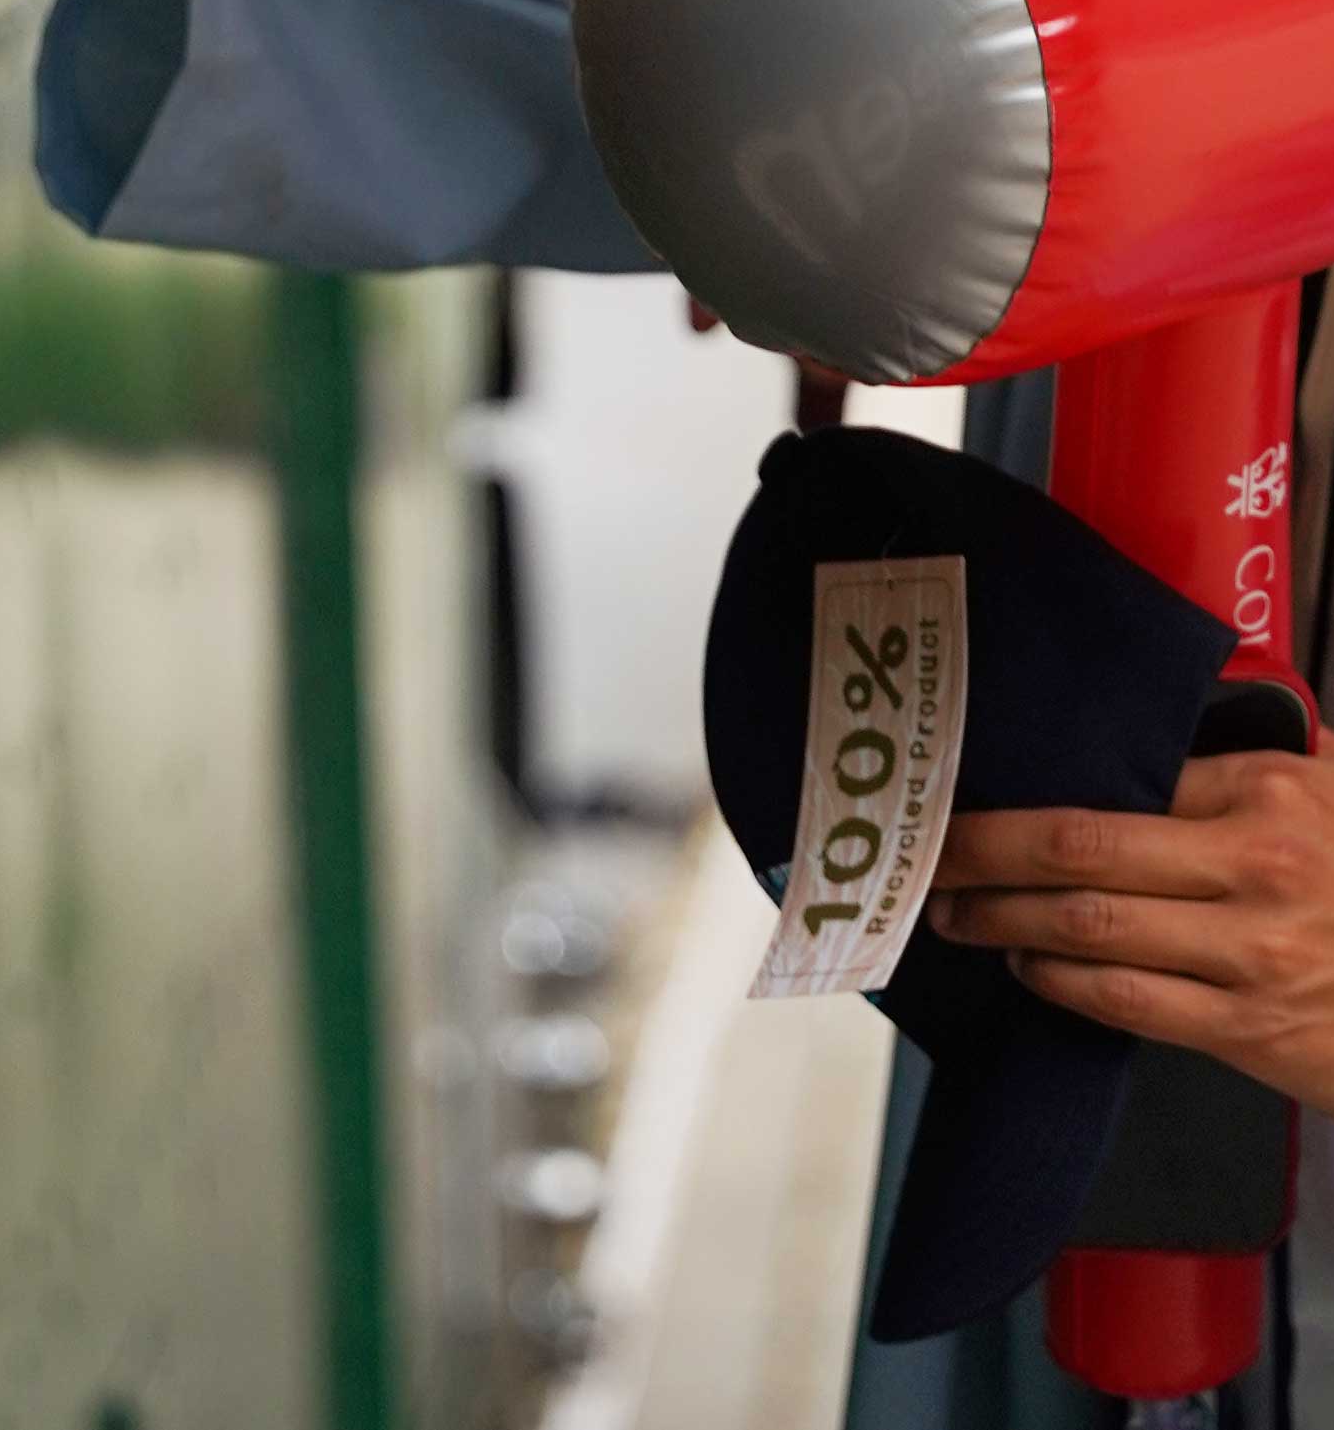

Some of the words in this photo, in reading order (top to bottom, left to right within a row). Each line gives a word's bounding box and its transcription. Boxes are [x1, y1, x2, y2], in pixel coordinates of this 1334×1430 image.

[804, 624, 909, 938] 100%
[866, 771, 925, 936] Recycled
[909, 617, 940, 759] Product
